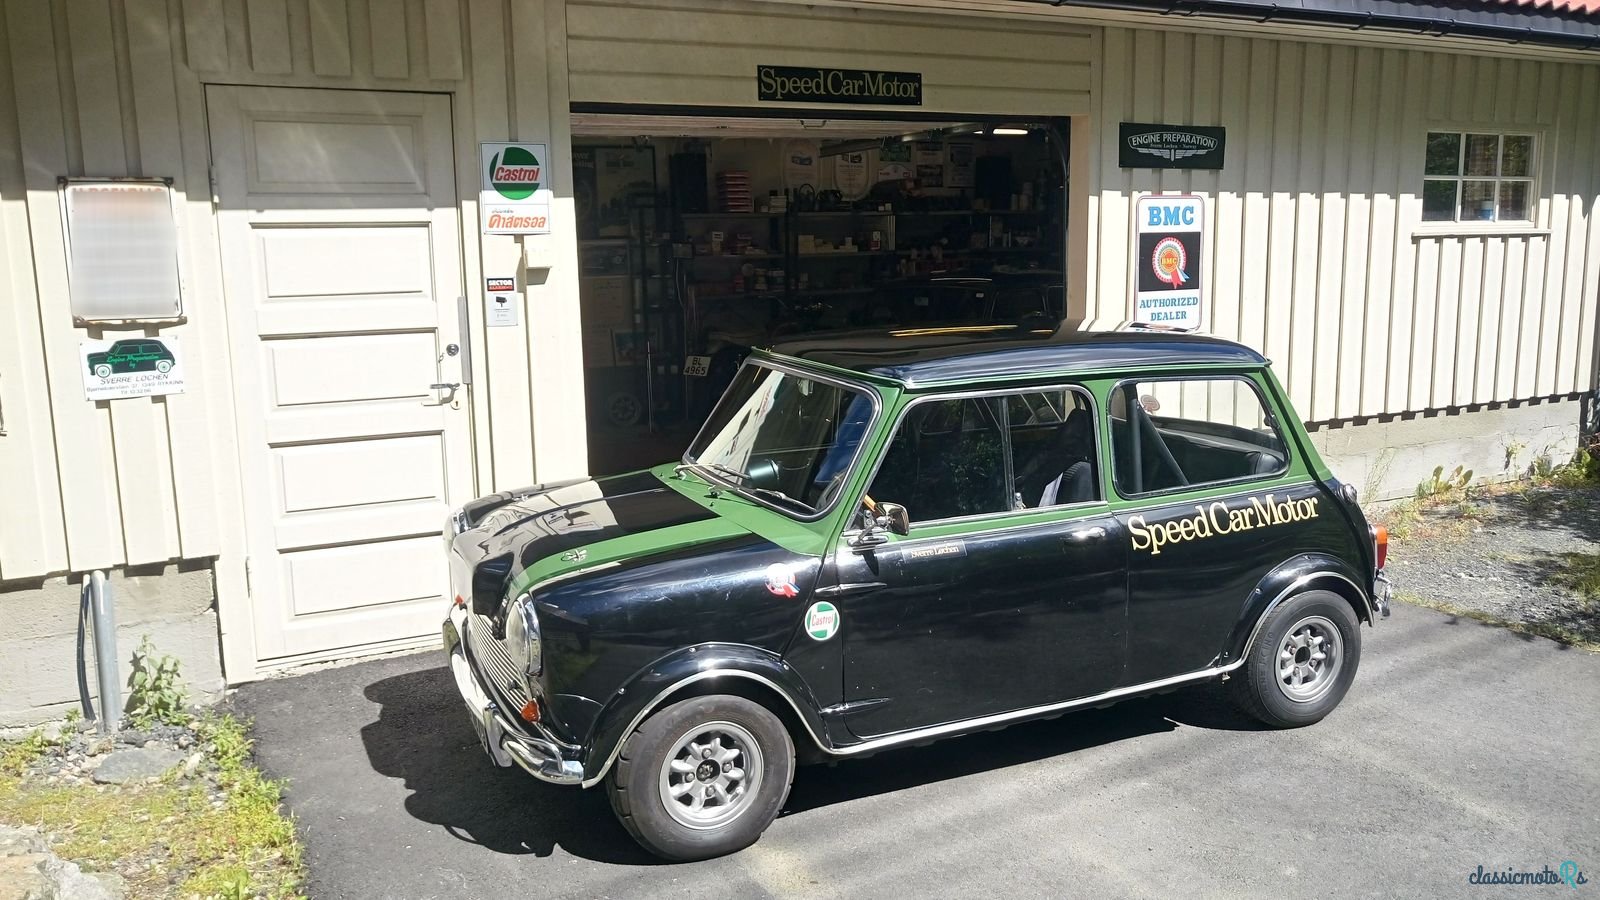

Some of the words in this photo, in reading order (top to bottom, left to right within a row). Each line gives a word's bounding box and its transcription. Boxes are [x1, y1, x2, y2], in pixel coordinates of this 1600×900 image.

[1131, 133, 1161, 146] ENGINE
[1162, 133, 1215, 148] PREPARATION
[494, 166, 541, 182] Castrol
[1147, 205, 1195, 226] BMC
[1161, 257, 1178, 265] BMC
[1139, 296, 1199, 309] AUTHORIZED
[1150, 311, 1188, 321] DEALER
[692, 356, 702, 366] BL
[684, 365, 707, 375] 4965
[100, 376, 132, 385] SVERRE
[811, 613, 834, 627] Castrol
